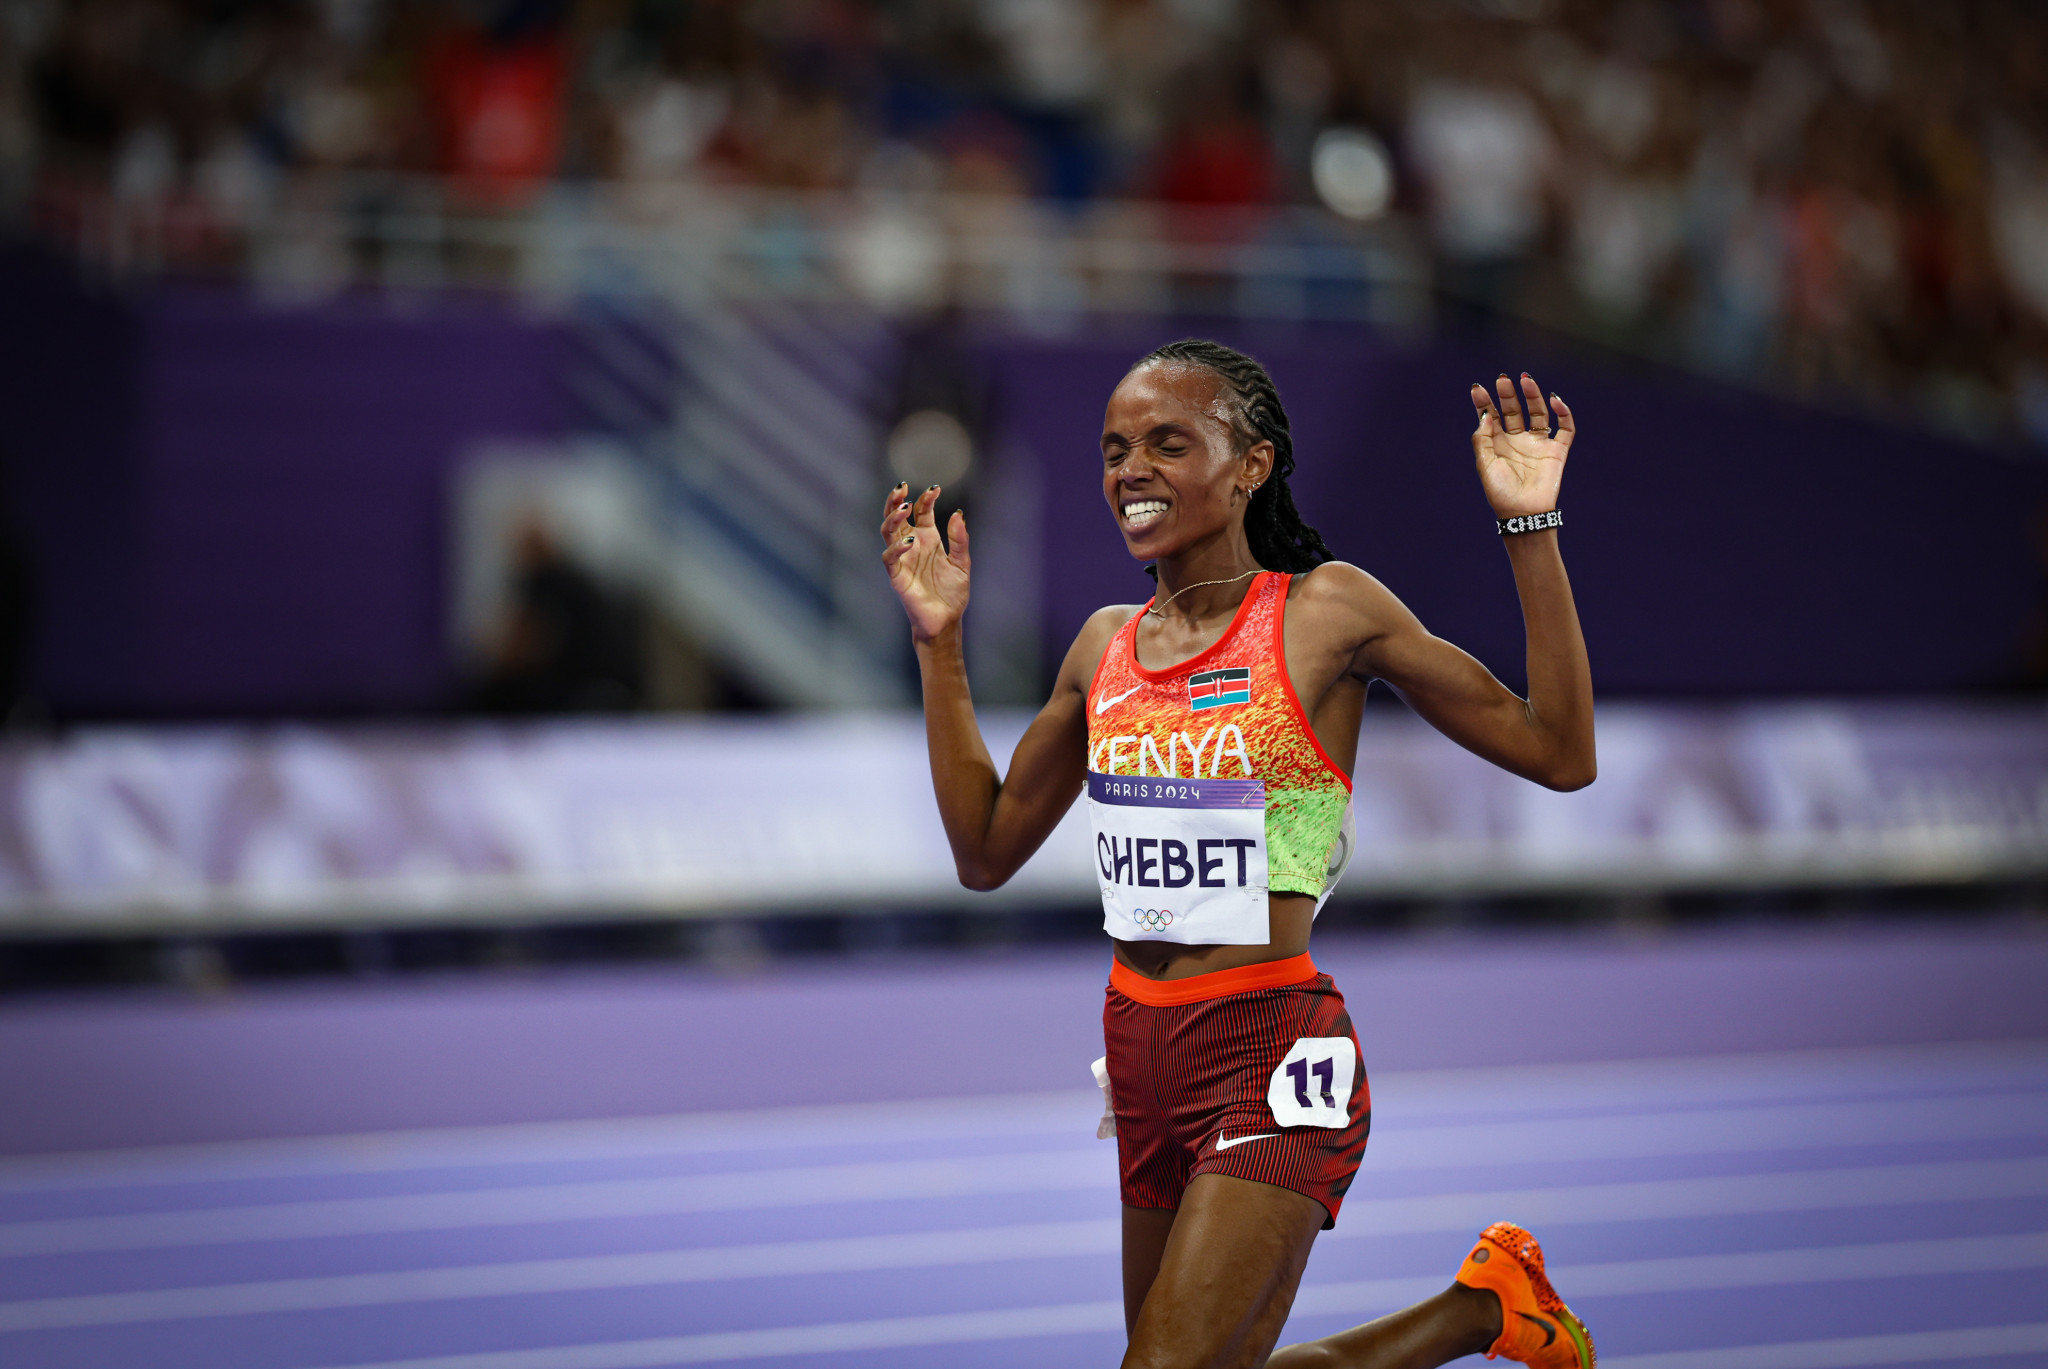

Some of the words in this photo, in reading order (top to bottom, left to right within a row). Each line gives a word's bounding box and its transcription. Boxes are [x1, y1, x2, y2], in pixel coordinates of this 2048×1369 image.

[1089, 724, 1253, 779] KENYA
[1155, 785, 1200, 800] 2024
[1097, 831, 1257, 888] CHEBET
[1286, 1056, 1336, 1109] 11
